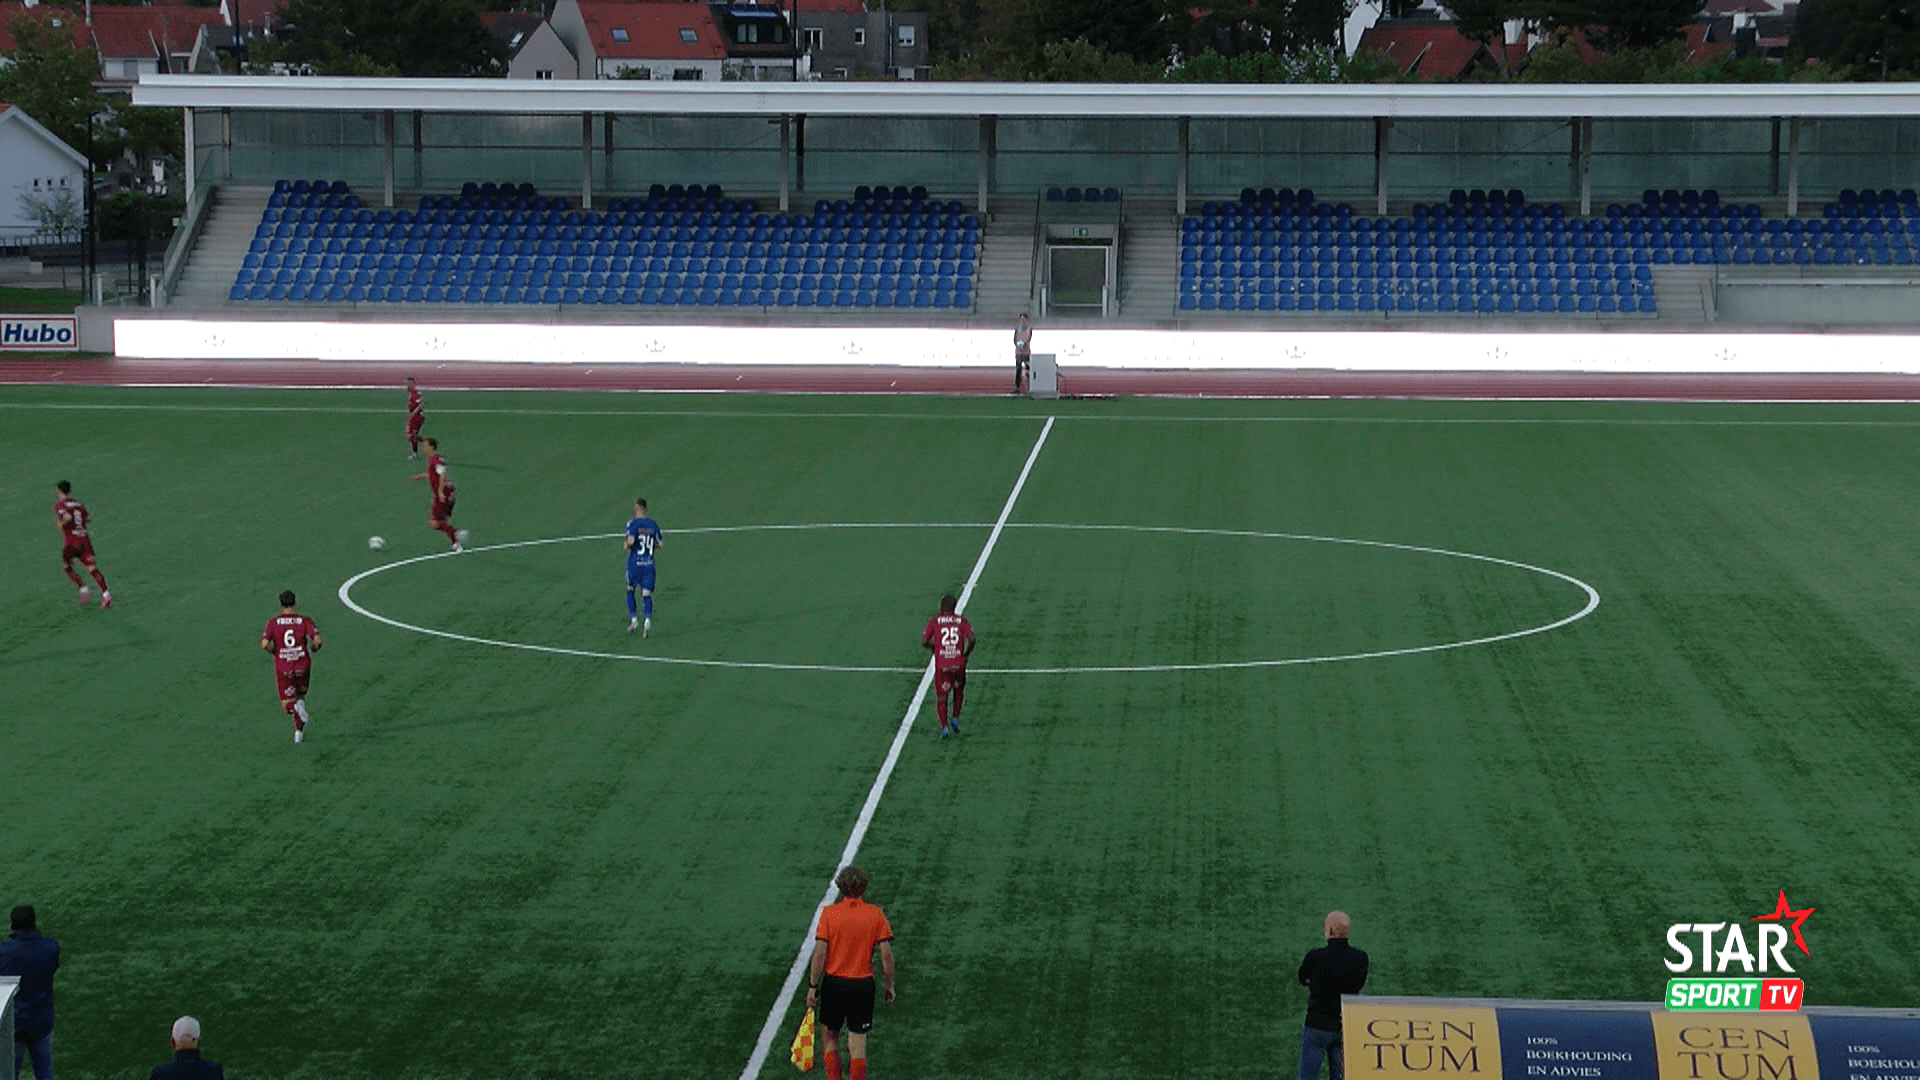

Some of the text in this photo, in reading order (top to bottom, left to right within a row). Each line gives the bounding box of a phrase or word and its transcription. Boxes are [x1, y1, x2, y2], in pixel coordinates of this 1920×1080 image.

[4, 323, 72, 343] Hubo
[637, 535, 654, 556] 34
[284, 629, 296, 647] 6
[940, 626, 960, 646] 25
[1366, 1019, 1476, 1042] CEN
[1527, 1036, 1558, 1045] 100%
[1678, 1026, 1790, 1050] CEN
[1363, 1043, 1481, 1073] TUM
[1526, 1050, 1633, 1062] BOEKHOUDING
[1848, 1045, 1881, 1053] 100%
[1527, 1065, 1602, 1077] EN ADVIES
[1676, 1051, 1798, 1080] TUM
